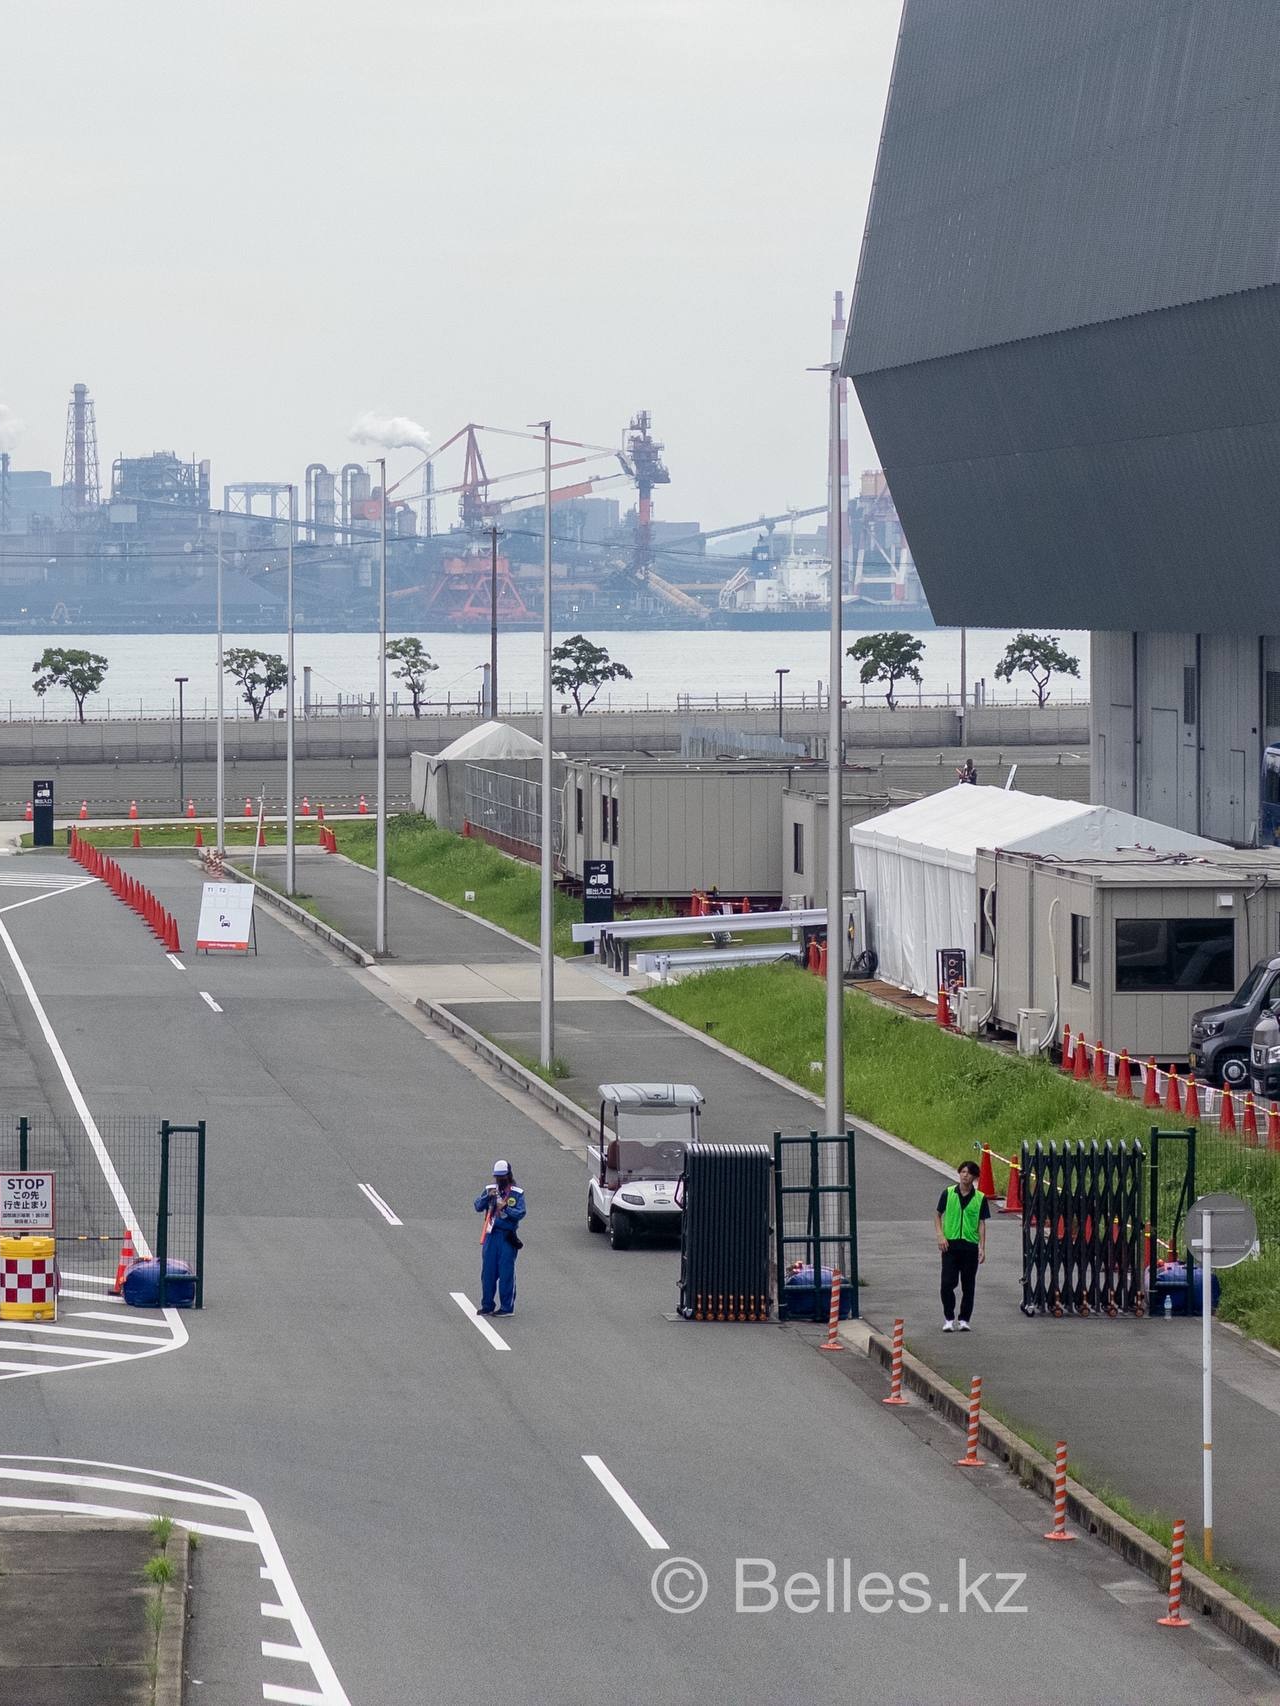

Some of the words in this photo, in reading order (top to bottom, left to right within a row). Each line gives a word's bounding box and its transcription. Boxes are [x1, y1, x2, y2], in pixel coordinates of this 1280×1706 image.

[600, 863, 607, 872] 2
[7, 1178, 45, 1190] STOP
[13, 1191, 40, 1200] この先
[3, 1200, 47, 1210] 行き止まり
